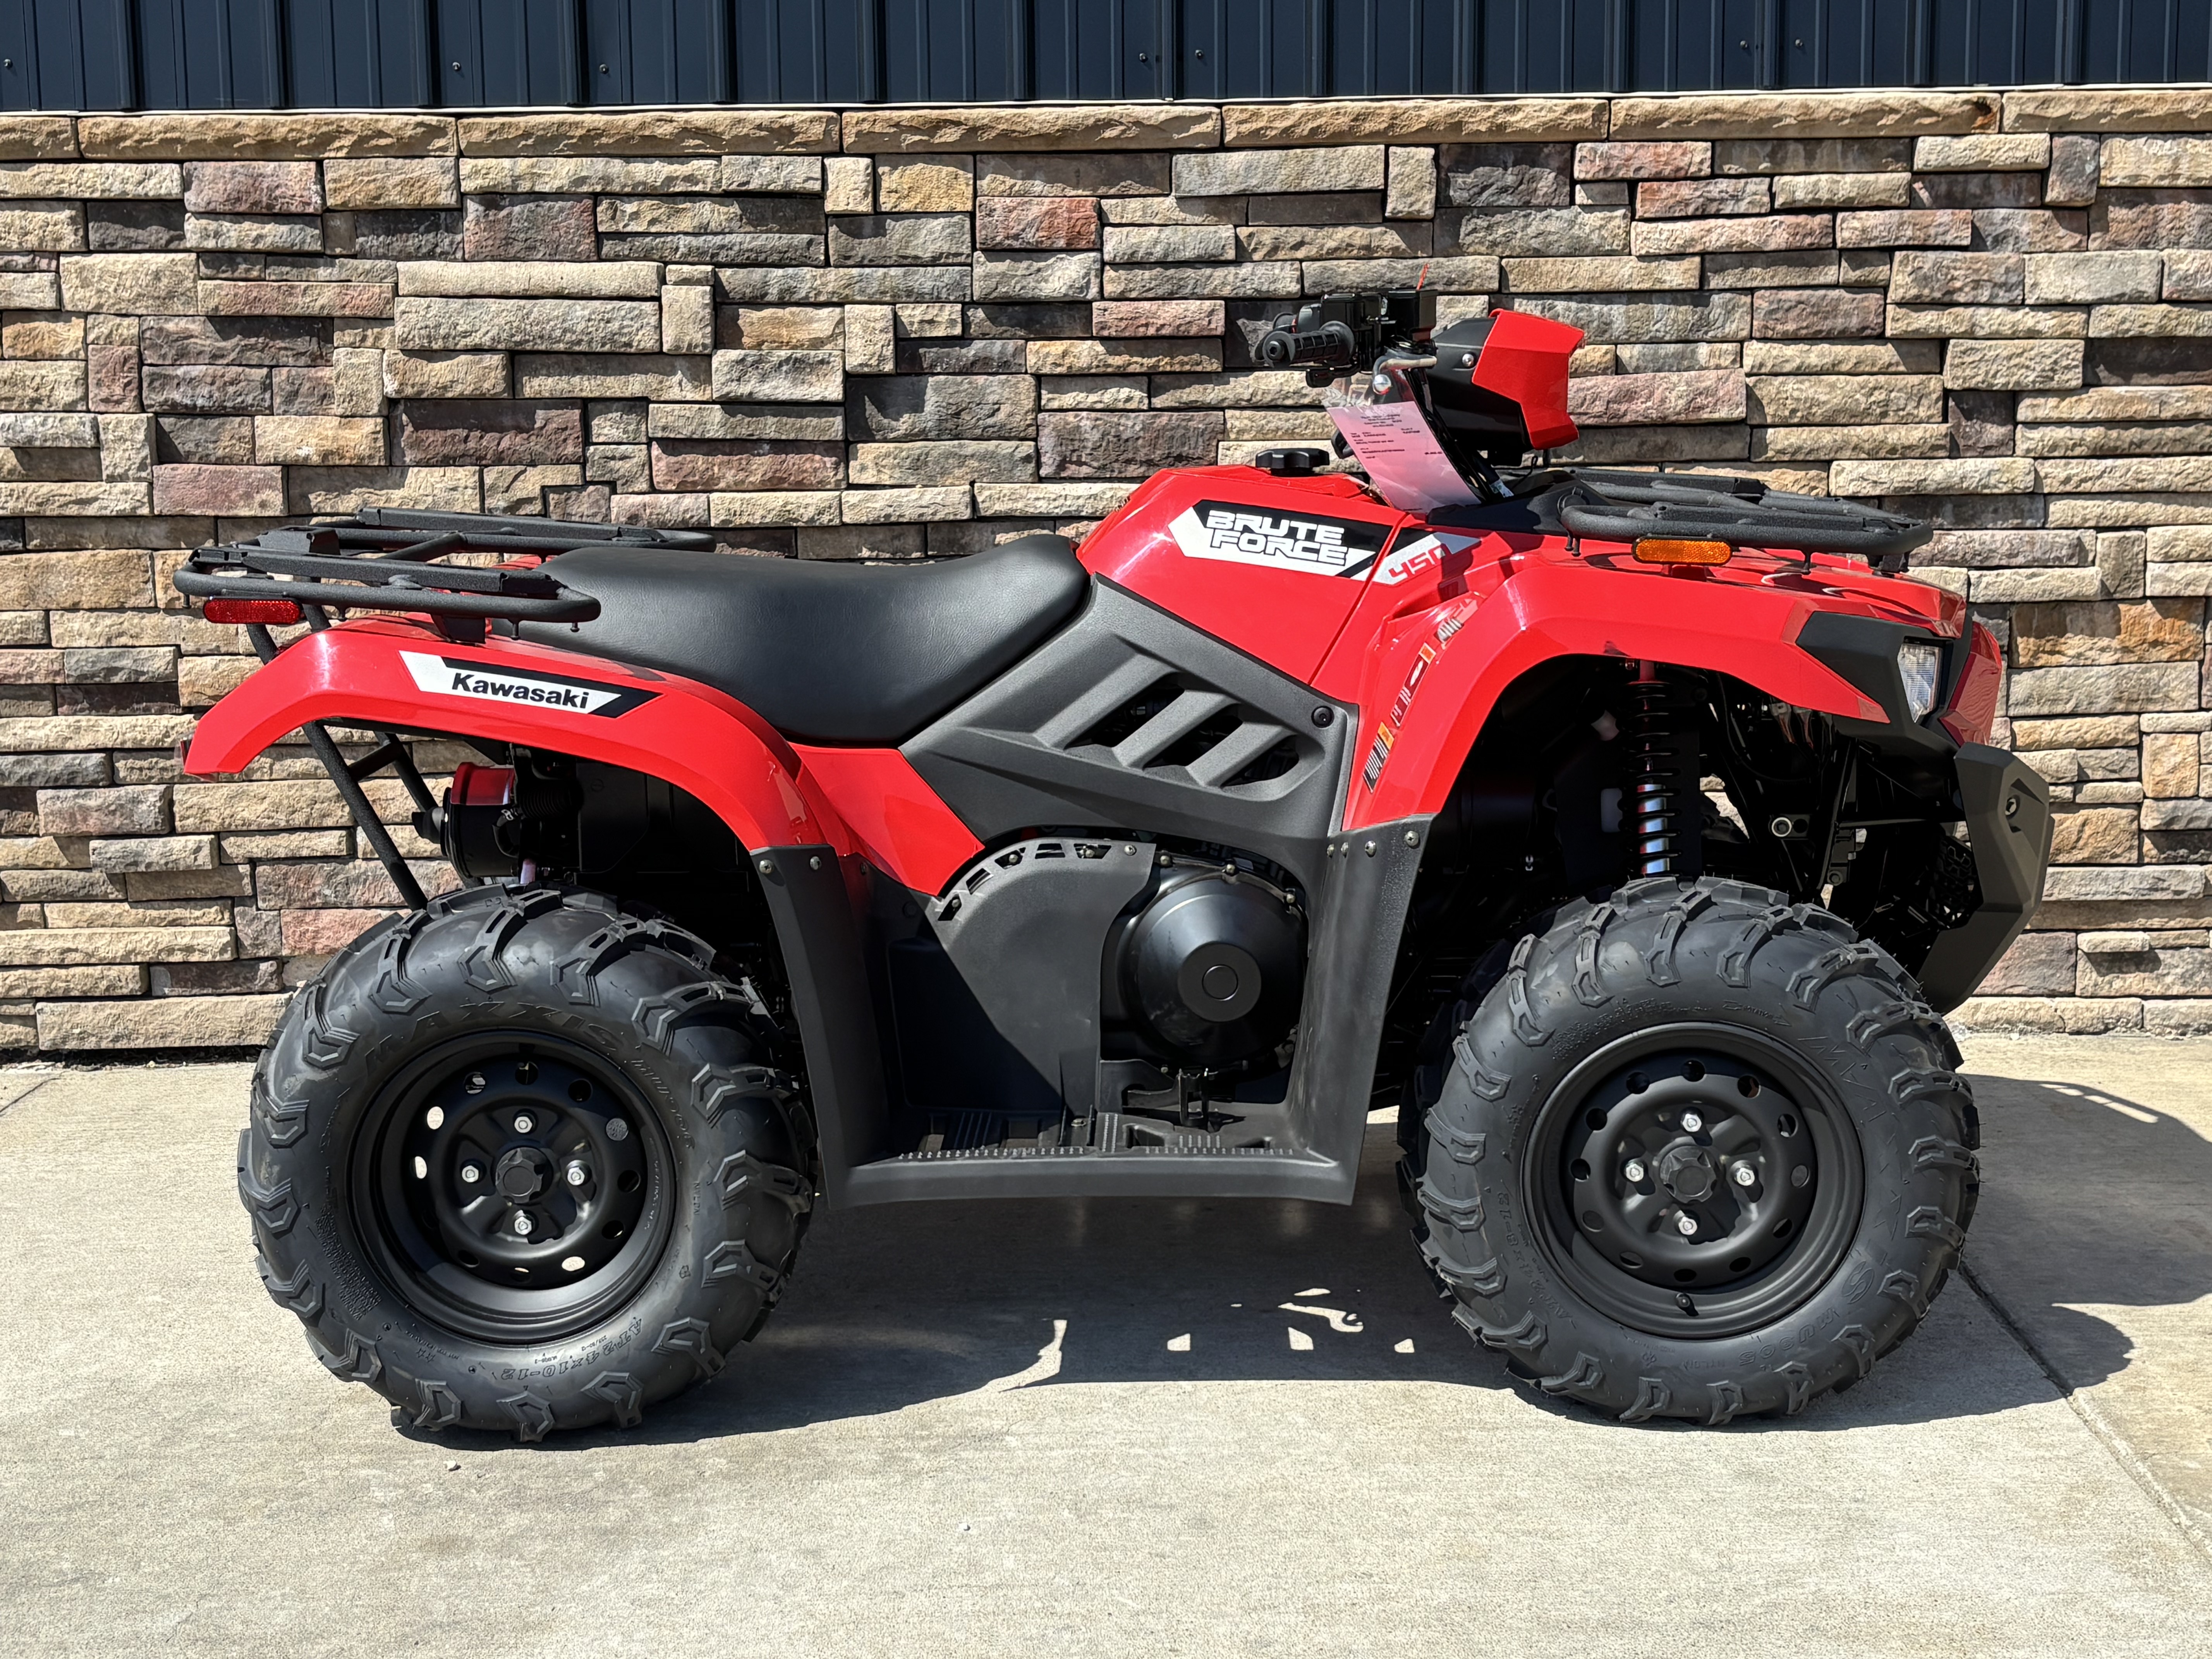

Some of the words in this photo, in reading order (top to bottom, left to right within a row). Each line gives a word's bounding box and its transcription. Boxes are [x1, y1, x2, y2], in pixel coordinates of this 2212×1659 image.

[1206, 510, 1345, 545] BRUTE
[1210, 528, 1348, 566] FORCE
[1388, 543, 1452, 579] 450
[452, 673, 589, 709] Kawasaki
[364, 1001, 617, 1078] MAXXIS
